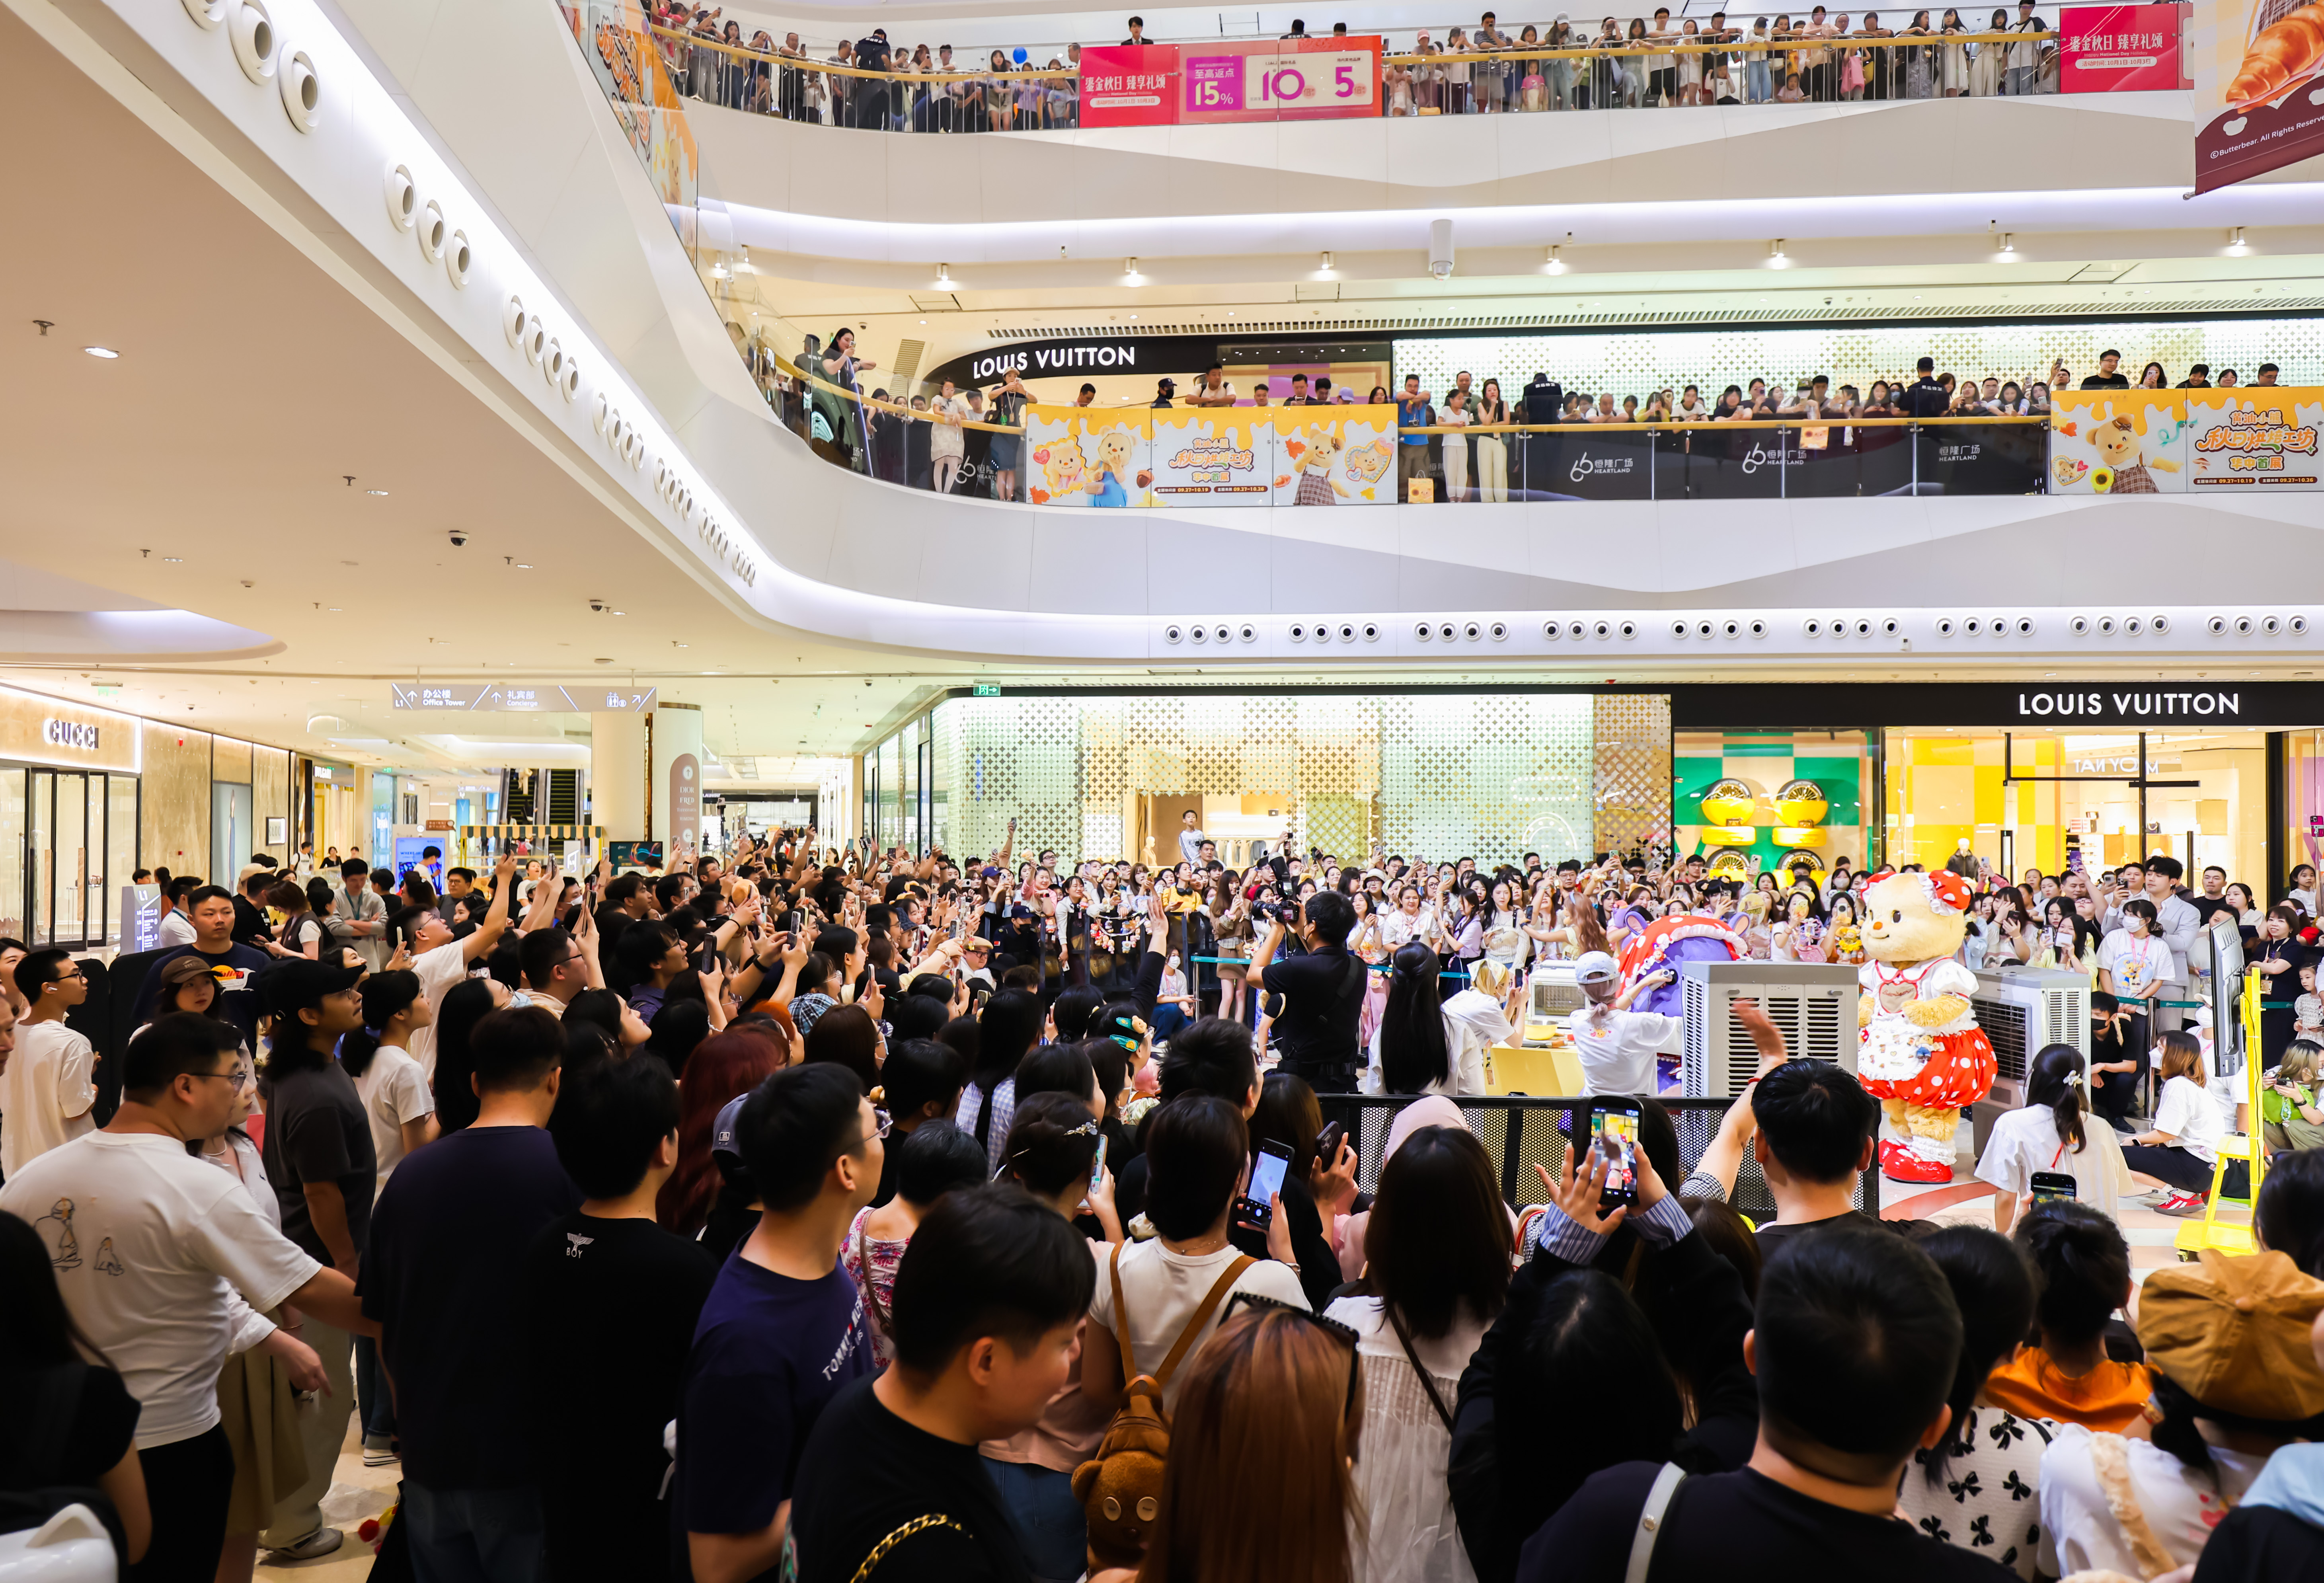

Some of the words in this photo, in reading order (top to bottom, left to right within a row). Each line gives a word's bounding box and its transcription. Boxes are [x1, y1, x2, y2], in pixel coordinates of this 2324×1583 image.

[2117, 32, 2163, 50] 臻享礼颂
[1195, 68, 1234, 78] 至高返点
[1263, 68, 1305, 101] 10
[1335, 66, 1355, 97] 5
[2260, 133, 2269, 142] All
[2271, 126, 2295, 137] Rights
[973, 352, 1028, 379] LOUIS
[1035, 346, 1135, 369] VUITTON
[2230, 411, 2281, 425] 黄油小熊
[1193, 438, 1229, 449] 黄油小熊
[1940, 444, 1980, 455] 恒隆广场
[1595, 458, 1633, 468] 恒隆广场
[2230, 456, 2283, 470] 华中首展
[1193, 472, 1229, 482] 华中首展
[423, 689, 451, 699] 办公楼
[507, 690, 535, 700] 礼宾部
[2020, 693, 2102, 715] LOUIS
[2113, 693, 2238, 715] VUITTON
[49, 719, 99, 749] GUCCI
[138, 890, 148, 901] L1
[566, 1247, 583, 1259] BOY
